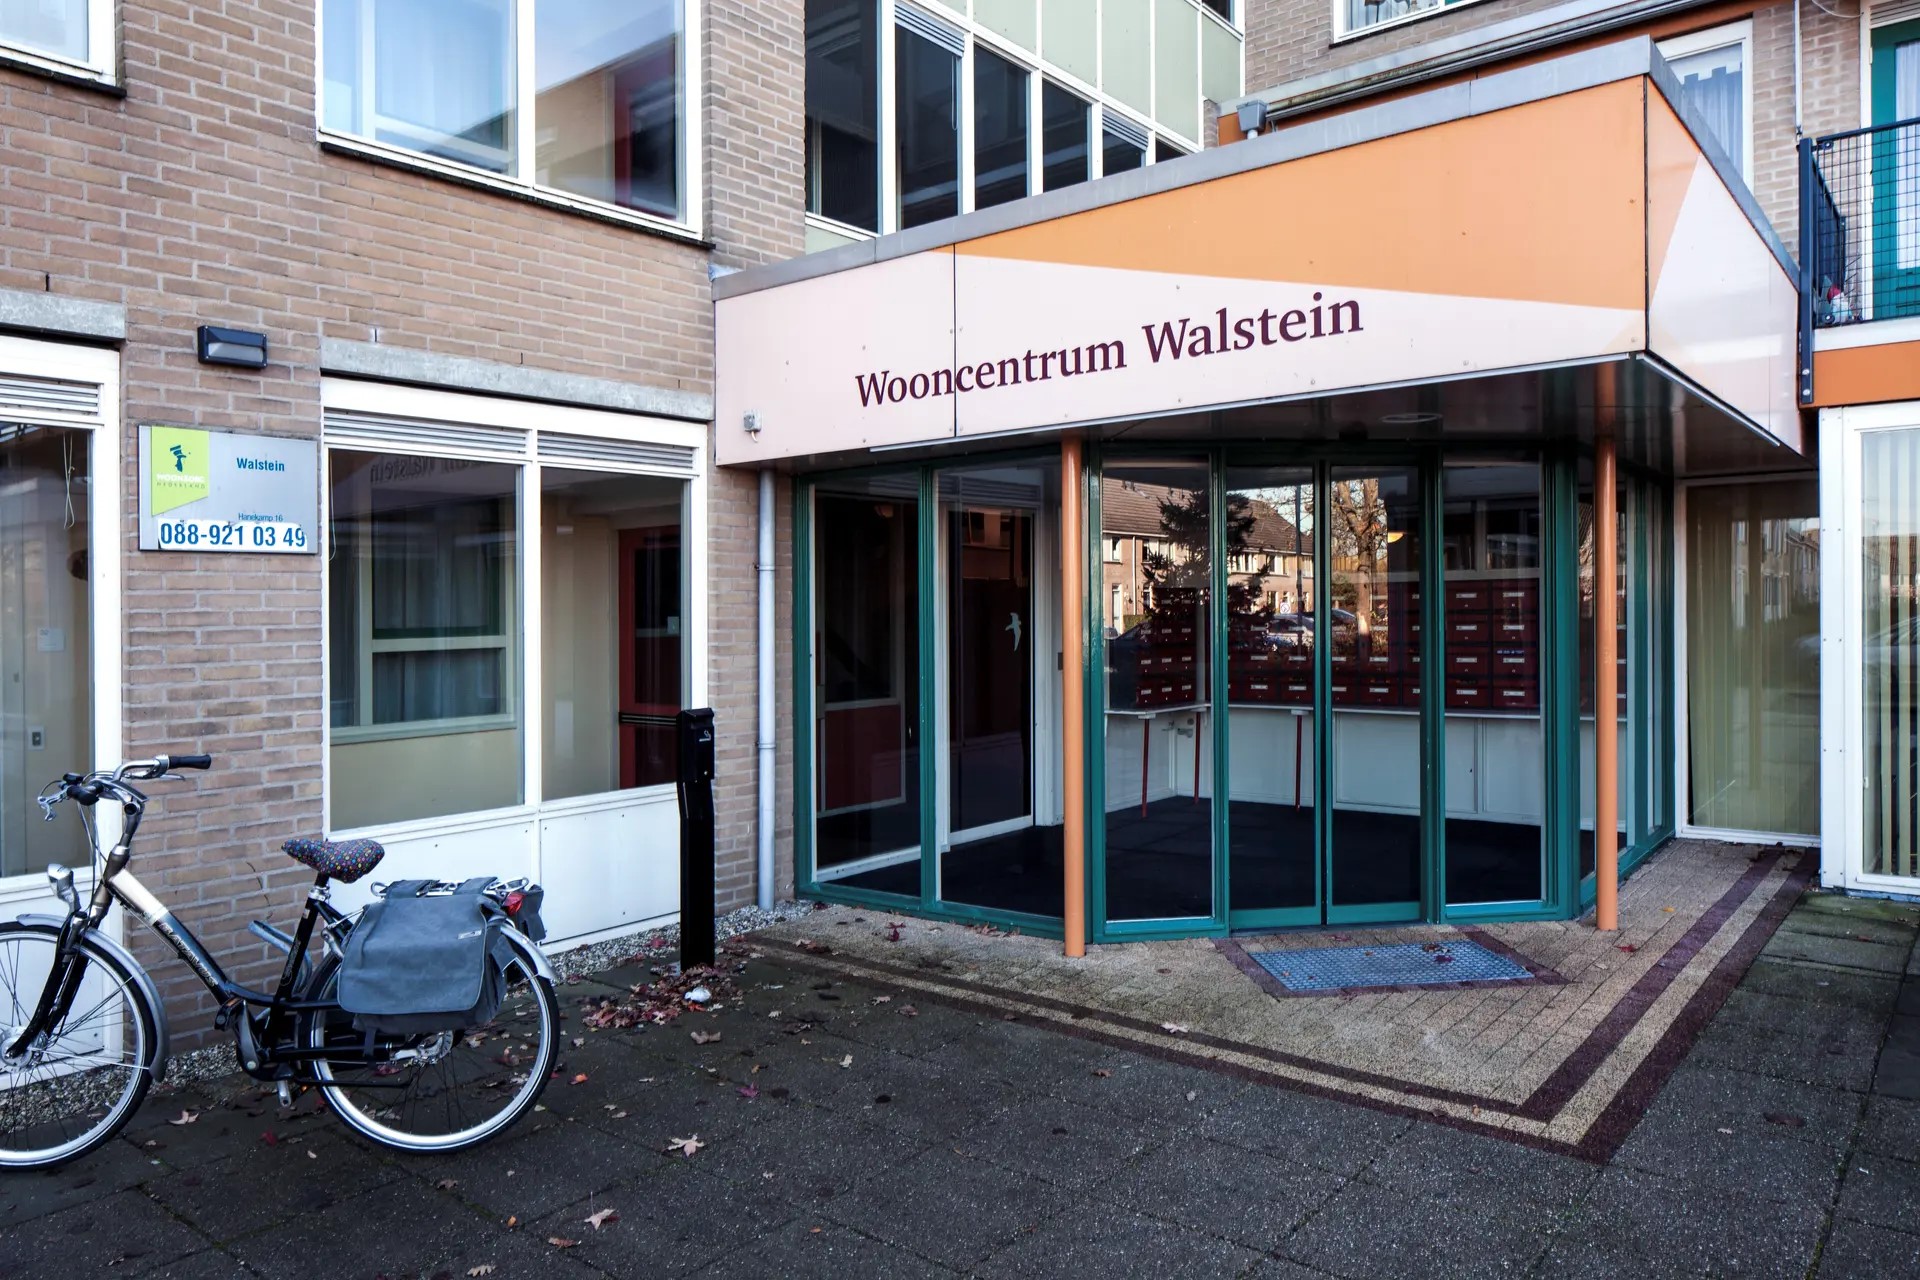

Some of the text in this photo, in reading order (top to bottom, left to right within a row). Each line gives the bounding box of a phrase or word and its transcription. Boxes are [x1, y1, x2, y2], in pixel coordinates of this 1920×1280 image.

[855, 292, 1364, 407] Wooncentrum Walstein
[236, 457, 285, 472] Walstein
[238, 513, 283, 522] Hanekamp 16
[160, 523, 306, 547] 088-921 03 49
[158, 922, 219, 987] BATAVUS
